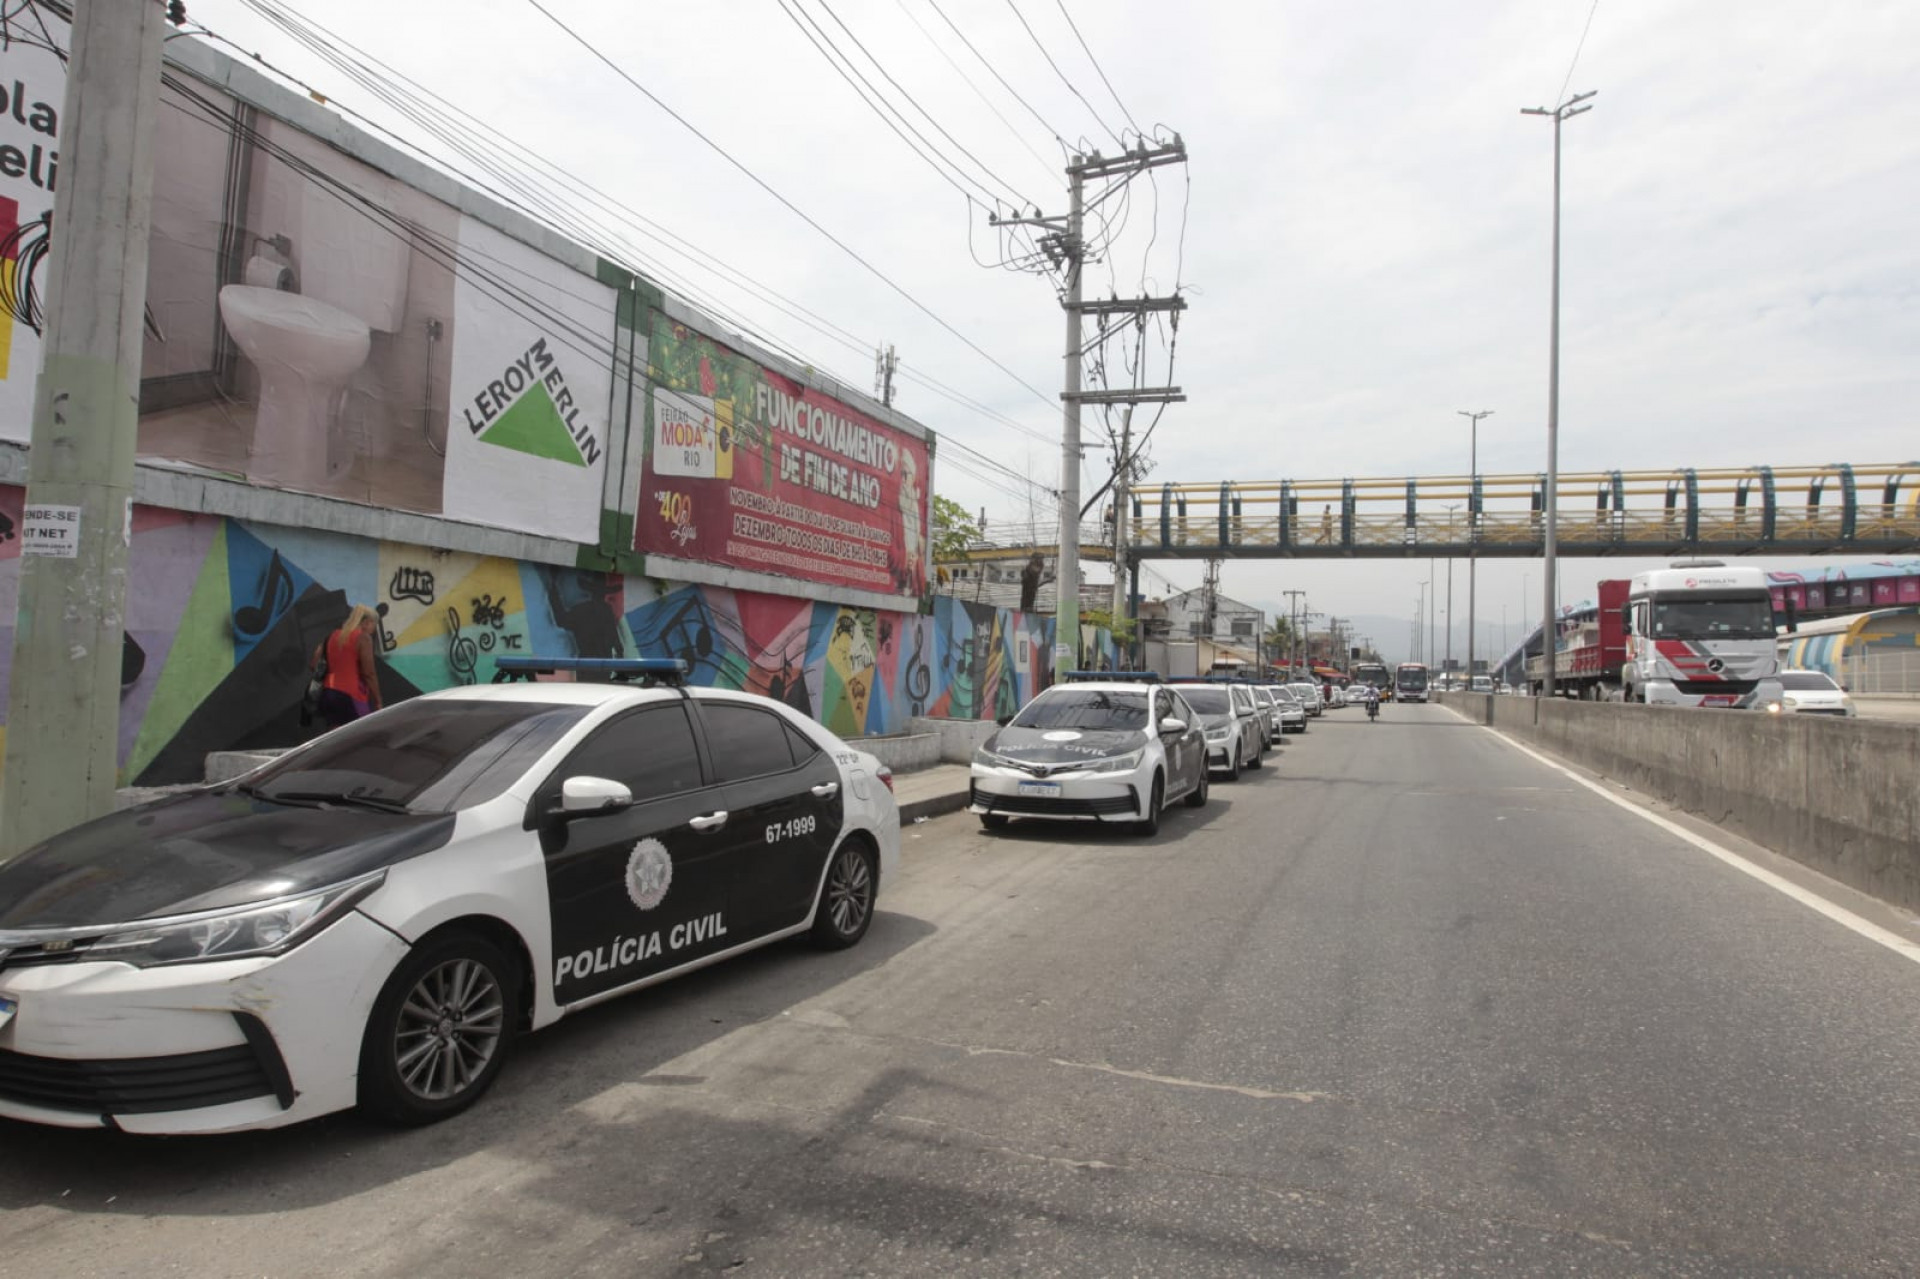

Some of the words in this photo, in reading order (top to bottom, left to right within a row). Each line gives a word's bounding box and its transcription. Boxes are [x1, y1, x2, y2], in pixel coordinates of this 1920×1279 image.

[463, 350, 535, 435] LEROY
[529, 336, 601, 466] MERLIN
[661, 407, 689, 423] FEIRÃO
[661, 421, 703, 447] MODA
[756, 381, 897, 473] FUNCIONAMENTO
[684, 450, 701, 467] RIO
[780, 443, 801, 484] DE
[804, 451, 829, 495] FIM
[831, 462, 848, 500] DE
[851, 470, 880, 509] ANO
[660, 491, 692, 524] 400
[39, 528, 67, 538] NET
[766, 815, 816, 844] 67-1999
[555, 935, 662, 986] POLÍCIA
[669, 911, 728, 949] CIVIL
